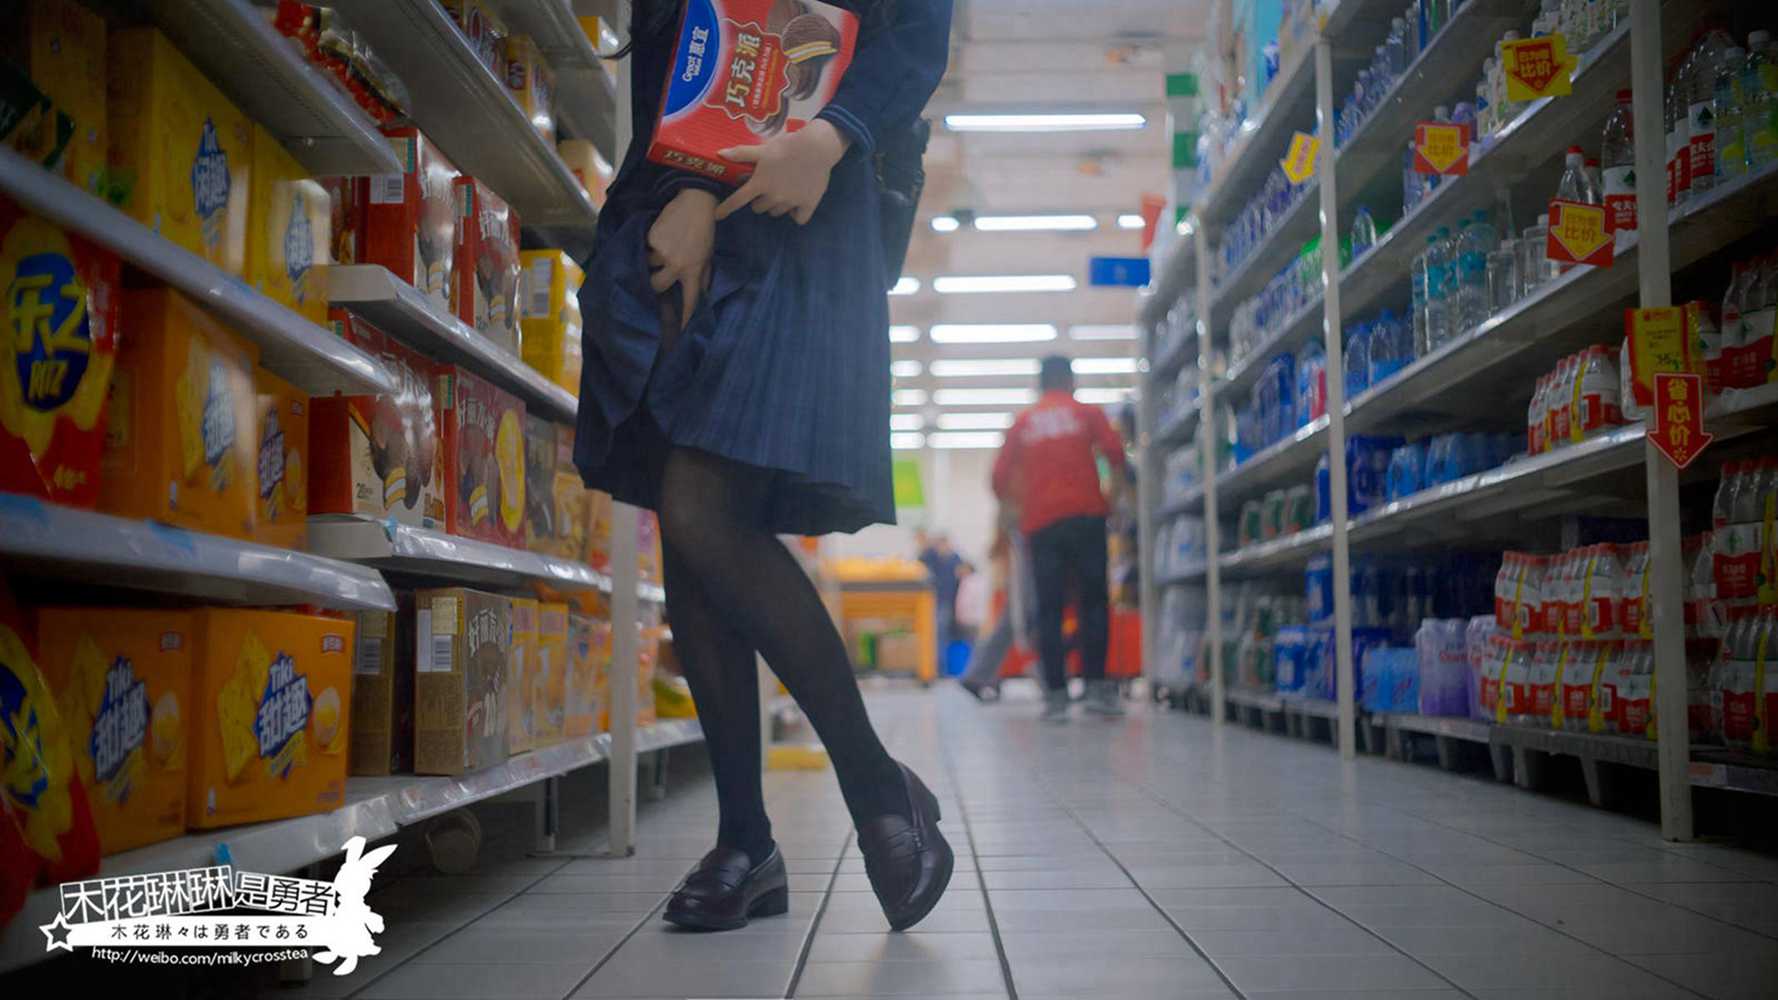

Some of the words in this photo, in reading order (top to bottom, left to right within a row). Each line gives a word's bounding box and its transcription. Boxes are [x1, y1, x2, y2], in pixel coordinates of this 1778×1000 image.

[726, 33, 761, 107] 巧克派
[1520, 61, 1552, 79] 比价
[8, 271, 92, 363] 乐之
[1666, 377, 1692, 447] 省心价
[258, 674, 308, 758] 甜趣
